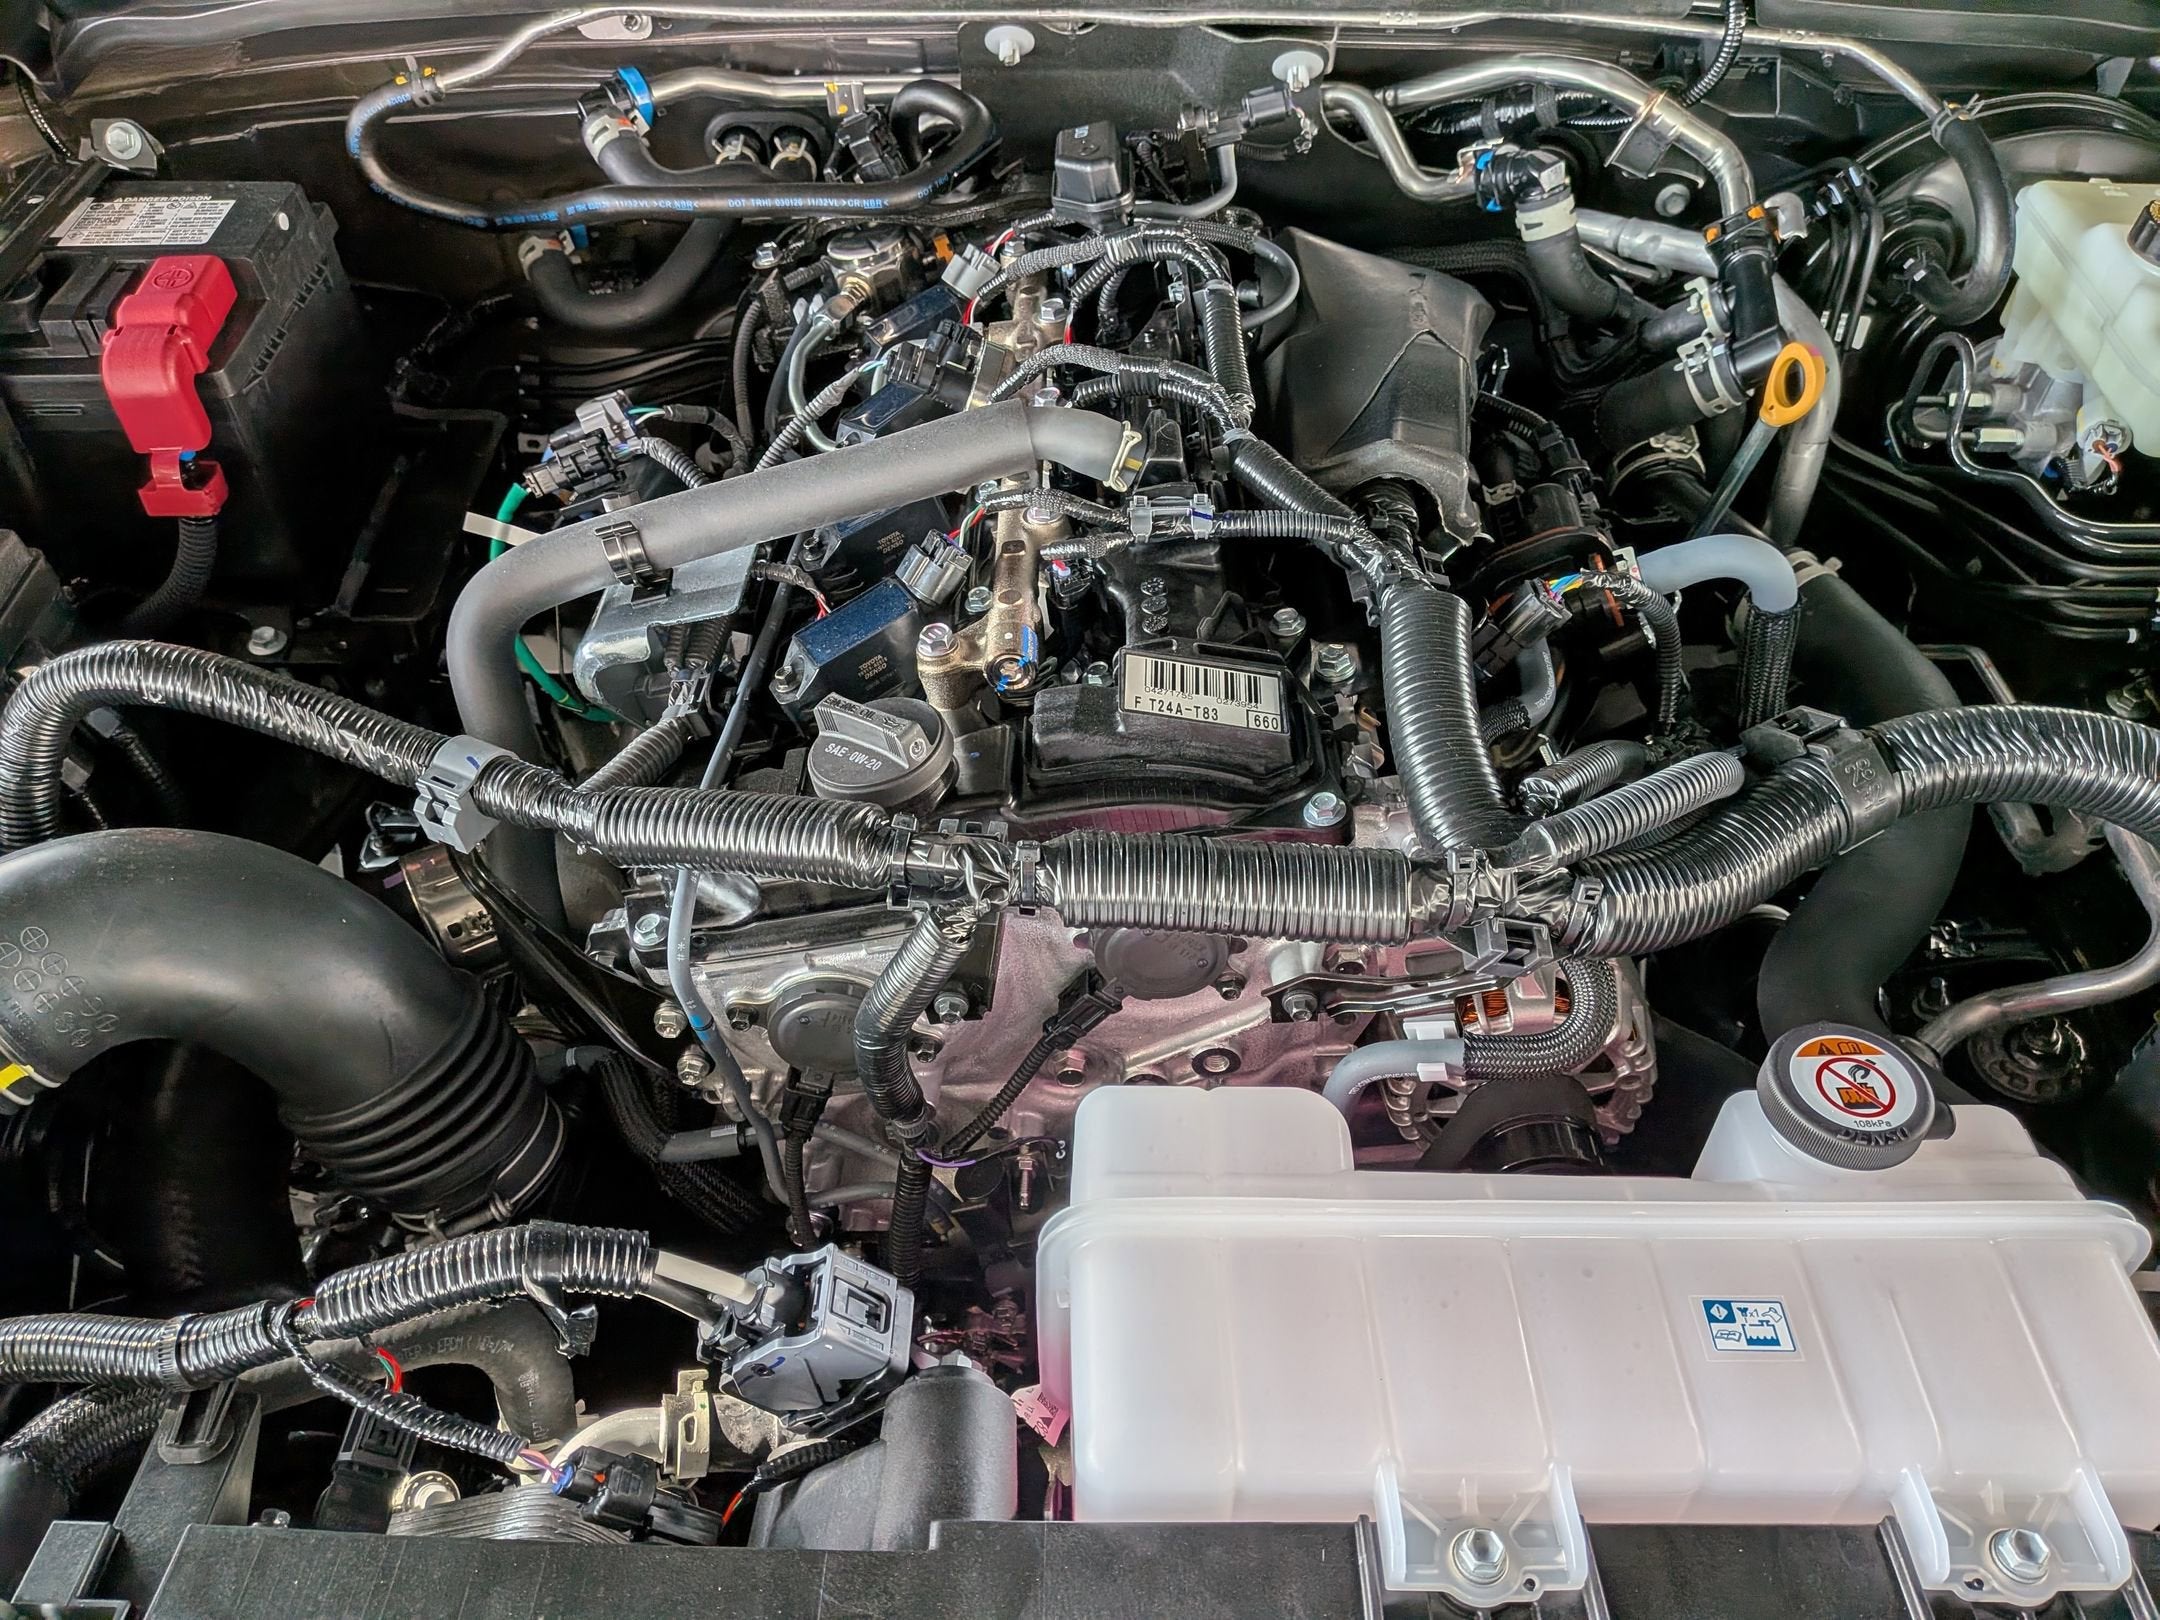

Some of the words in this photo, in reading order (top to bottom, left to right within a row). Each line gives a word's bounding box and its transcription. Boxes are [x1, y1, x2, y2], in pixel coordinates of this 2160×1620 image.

[728, 199, 746, 208] DOT
[878, 531, 901, 545] TOYOTA
[859, 654, 883, 669] TOYOTA
[864, 662, 887, 680] DENSO
[822, 697, 859, 715] ENGINE
[859, 708, 878, 721] OIL
[1134, 695, 1142, 709] F
[1149, 698, 1219, 721] T24A-T83
[1253, 714, 1279, 730] 660
[824, 742, 849, 757] SAE
[848, 751, 883, 771] 0W-20
[1853, 1120, 1893, 1128] 108kPa
[1836, 1127, 1909, 1146] DENSO
